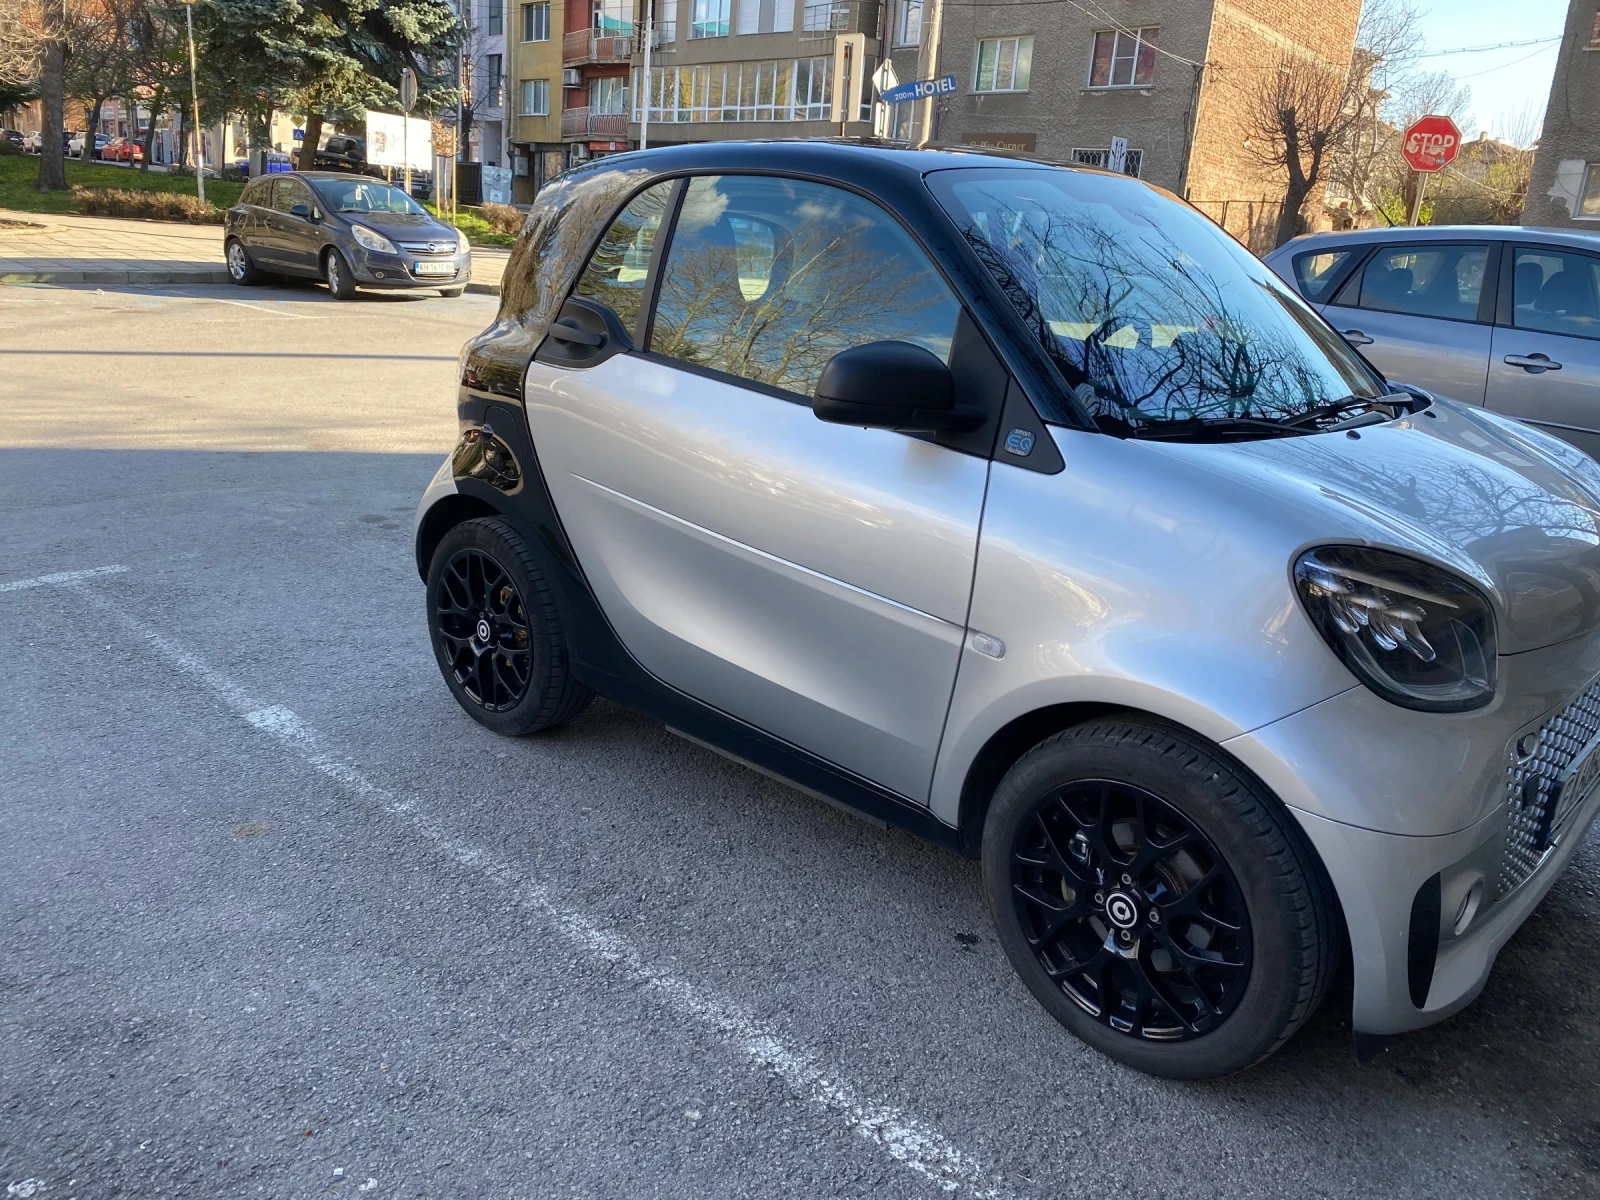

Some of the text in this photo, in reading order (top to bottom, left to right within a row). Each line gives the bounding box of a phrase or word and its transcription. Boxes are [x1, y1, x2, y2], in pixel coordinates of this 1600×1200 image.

[894, 78, 955, 100] 200m HOTEL
[1407, 132, 1455, 155] STOP
[1007, 434, 1032, 450] EQ
